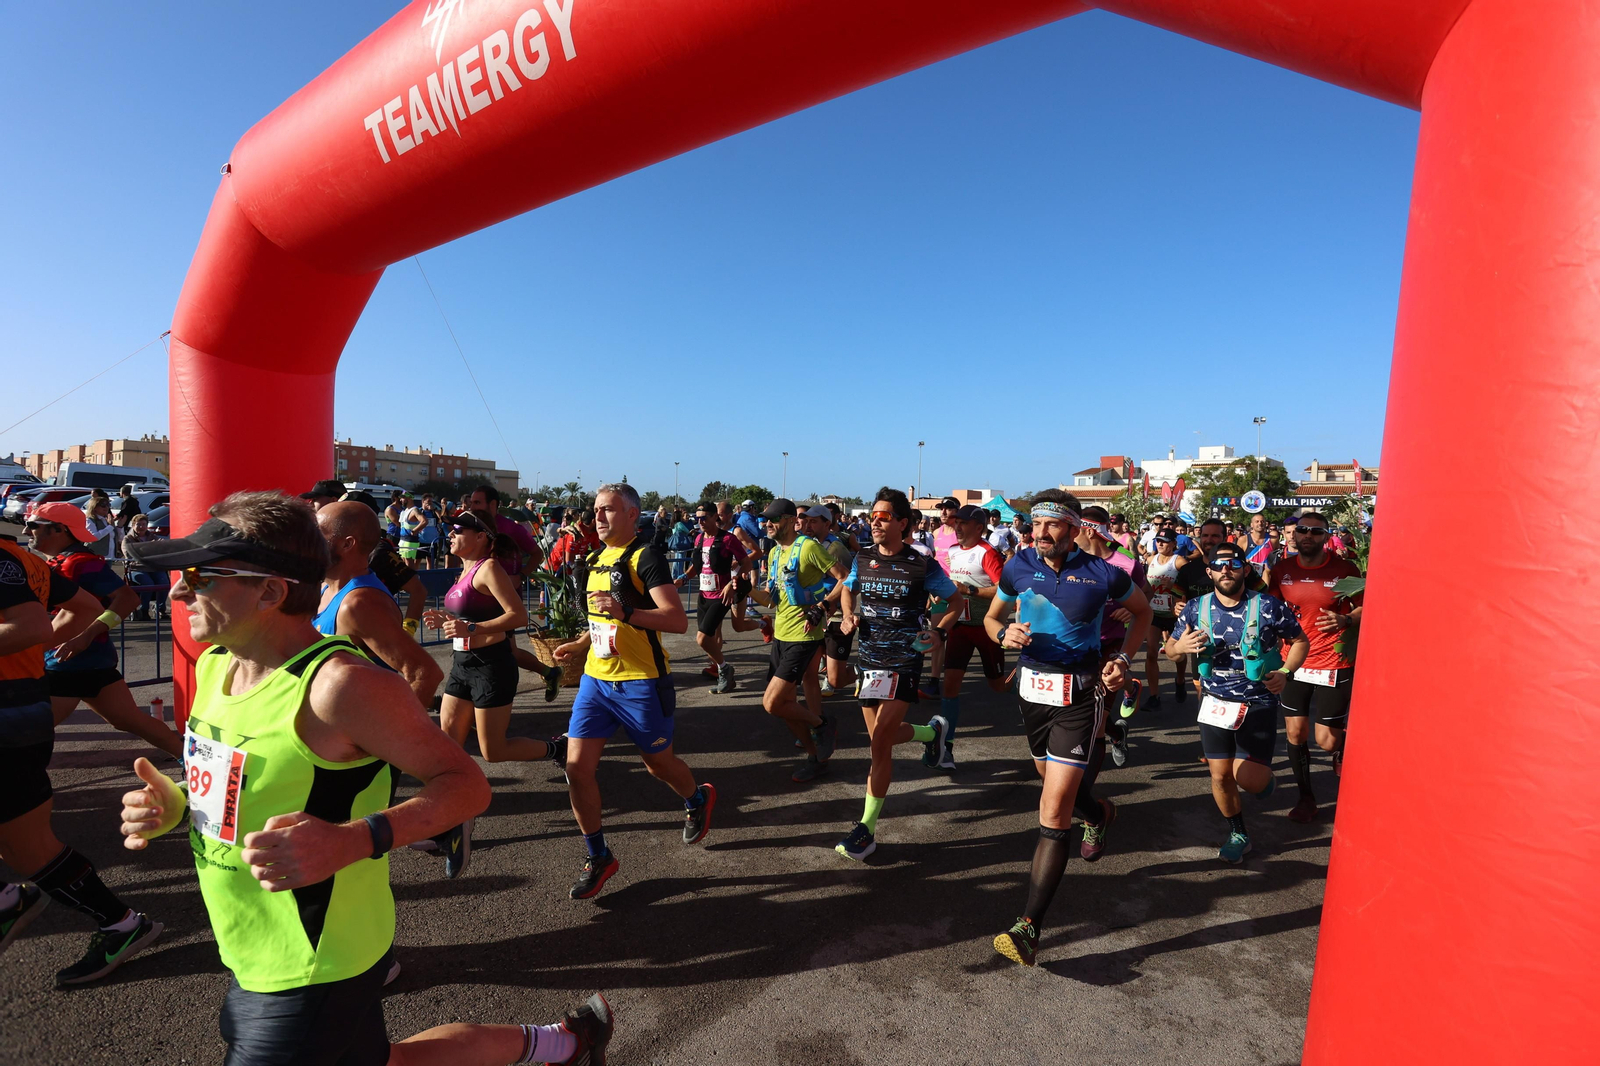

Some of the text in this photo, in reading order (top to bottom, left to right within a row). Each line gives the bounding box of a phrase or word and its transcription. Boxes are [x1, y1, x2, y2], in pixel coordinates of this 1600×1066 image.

[363, 0, 577, 164] TEAMERGY
[1272, 498, 1298, 506] TRAIL
[870, 679, 882, 688] 97
[1030, 677, 1054, 691] 152
[1211, 704, 1226, 716] 20
[224, 766, 240, 828] PIRATA
